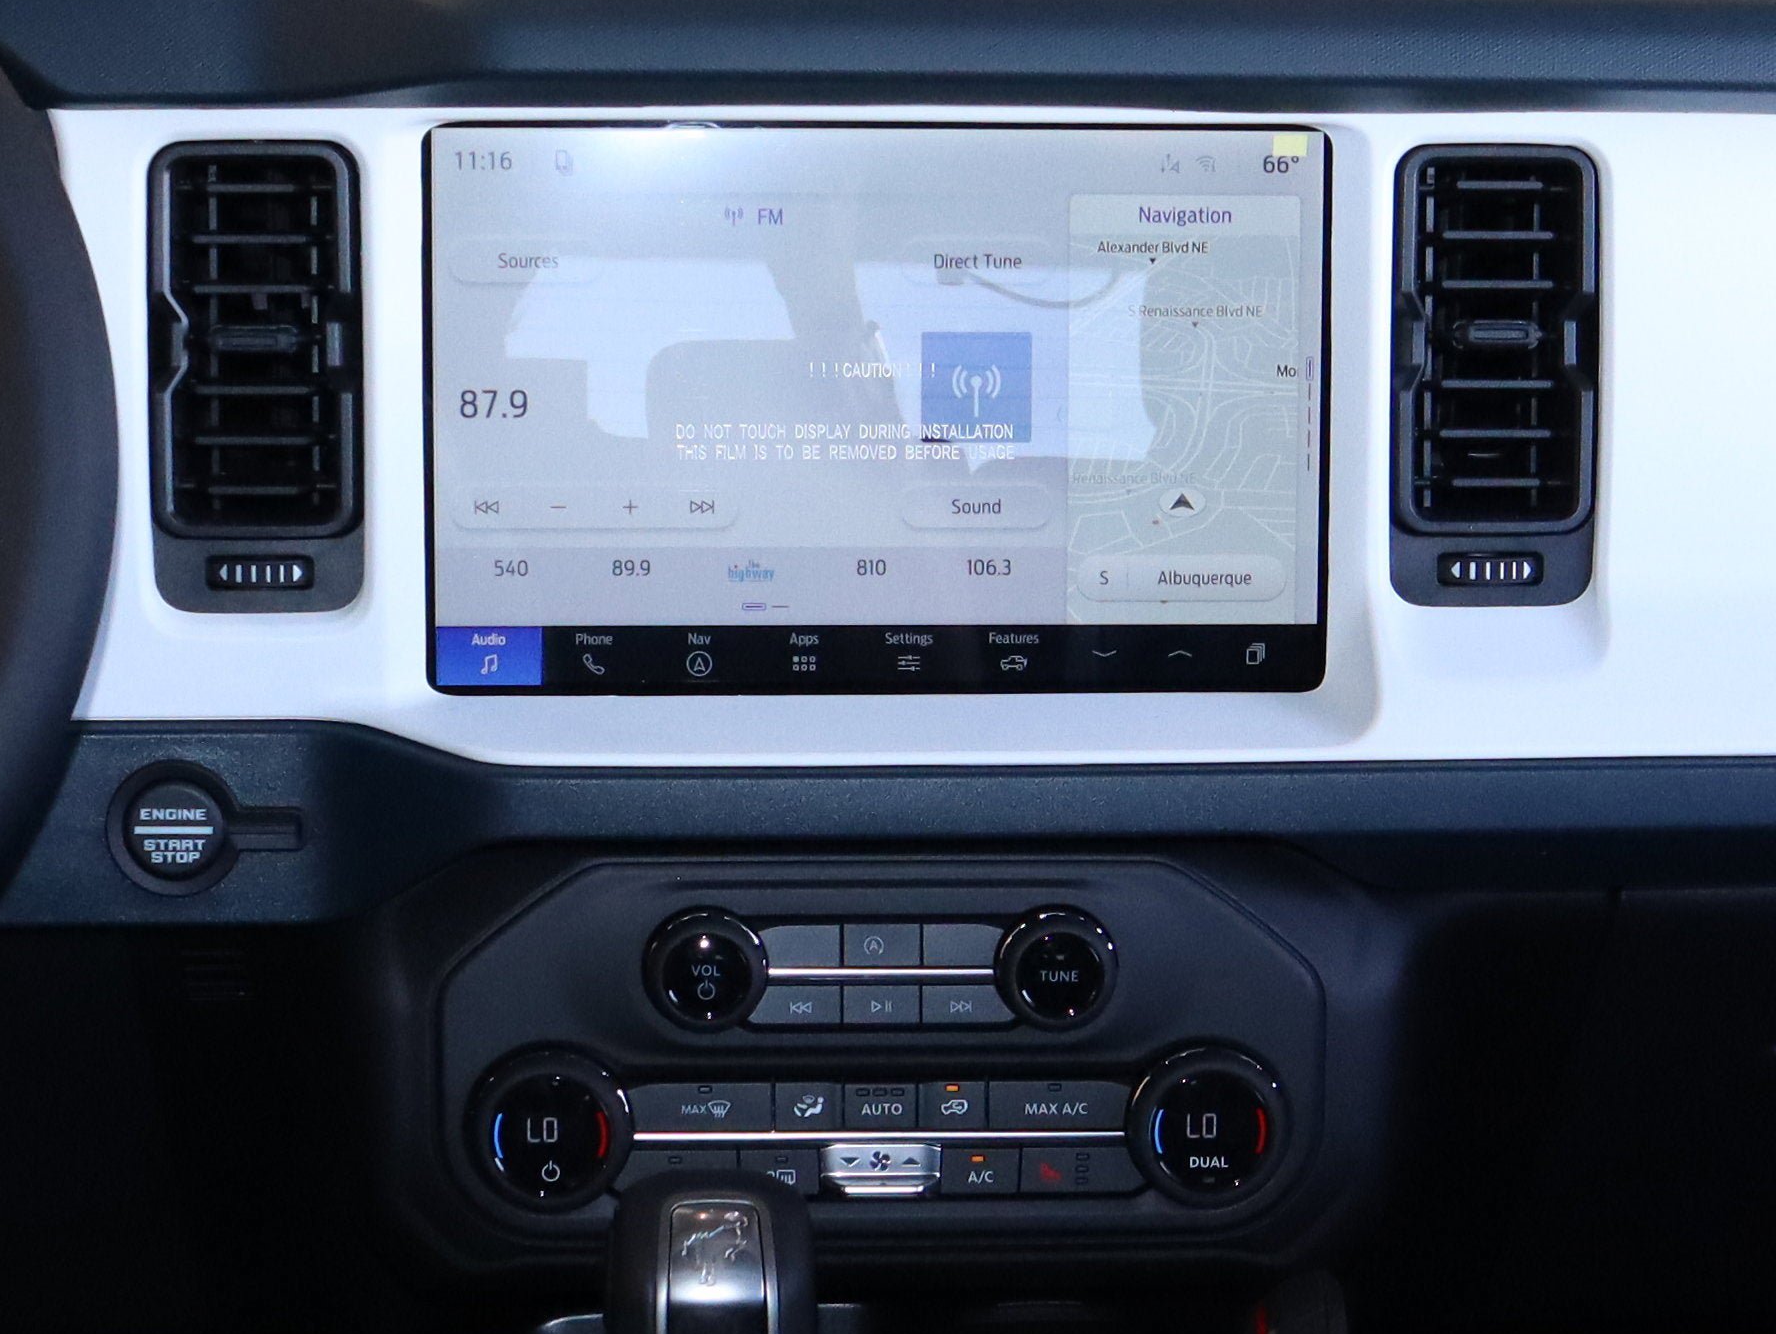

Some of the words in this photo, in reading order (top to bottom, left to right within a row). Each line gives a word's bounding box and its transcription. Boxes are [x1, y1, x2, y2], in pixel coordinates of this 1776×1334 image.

[454, 150, 512, 171] 11:16
[756, 208, 784, 225] FM
[1138, 206, 1232, 227] Navigation
[1097, 241, 1159, 254] Alexander
[1162, 241, 1189, 254] Blvd
[1191, 242, 1208, 254] NE
[497, 252, 559, 269] Sources
[933, 253, 978, 269] Direct
[984, 253, 1022, 269] Tune
[1139, 305, 1214, 317] Renaissance
[1216, 305, 1243, 317] Blvd
[1246, 306, 1263, 317] NE
[842, 363, 901, 378] CAUTION
[458, 388, 529, 420] 87.9
[675, 424, 695, 440] DO
[704, 424, 732, 440] NOT
[739, 424, 786, 440] TOUCH
[794, 424, 851, 440] DISPLAY
[858, 424, 911, 440] DURING
[918, 424, 1014, 440] INSTALLATION
[677, 445, 707, 460] THIS
[715, 445, 746, 460] FILM
[754, 445, 767, 460] IS
[775, 445, 794, 460] TO
[802, 445, 821, 460] BE
[828, 445, 897, 460] REMOVED
[905, 445, 960, 460] BEFORE
[968, 445, 1015, 460] USAGE
[951, 498, 1002, 514] Sound
[493, 559, 529, 577] 540
[611, 559, 652, 577] 89.9
[727, 565, 775, 582] highway
[856, 559, 887, 576] 810
[966, 559, 1012, 576] 106.3
[1099, 570, 1109, 586] S
[1157, 569, 1253, 588] Albuquerque
[471, 632, 506, 646] Audio
[575, 632, 613, 646] Phone
[687, 632, 711, 645] Nav
[789, 632, 819, 649] Apps
[884, 632, 933, 649] Settings
[988, 632, 1039, 645] Features
[139, 808, 207, 821] ENGINE
[143, 839, 206, 851] START
[150, 851, 201, 863] STOP
[691, 964, 720, 977] VOL
[1039, 969, 1079, 983] TUNE
[681, 1104, 707, 1115] MAX
[861, 1102, 903, 1115] AUTO
[1024, 1102, 1059, 1115] MAX
[1062, 1102, 1089, 1116] A/C
[1189, 1155, 1229, 1168] DUAL
[967, 1170, 995, 1184] A/C
